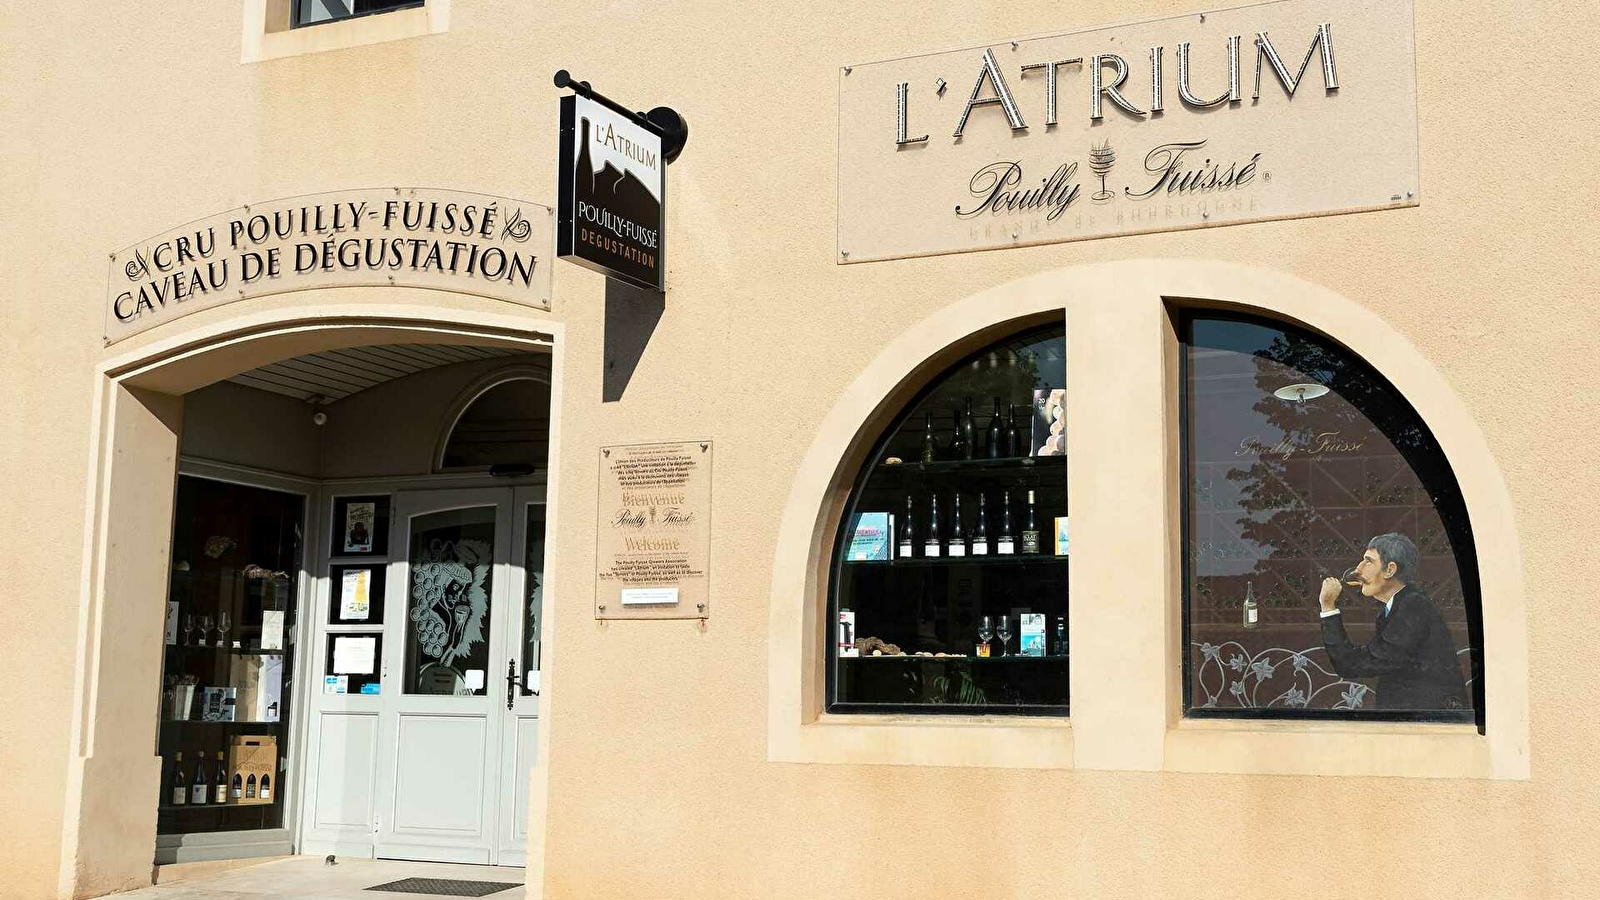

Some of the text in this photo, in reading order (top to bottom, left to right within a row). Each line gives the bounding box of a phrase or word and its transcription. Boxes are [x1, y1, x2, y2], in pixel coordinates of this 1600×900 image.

[954, 160, 1082, 221] Pouilly
[1125, 138, 1262, 198] Fuissé
[153, 201, 498, 272] CRU POUILLY-FUISSÉ
[578, 200, 658, 249] POUILLY-FUISSÉ
[581, 227, 655, 269] DEGUSTATION
[113, 233, 537, 321] CAVEAU DE DÉGUSTATION
